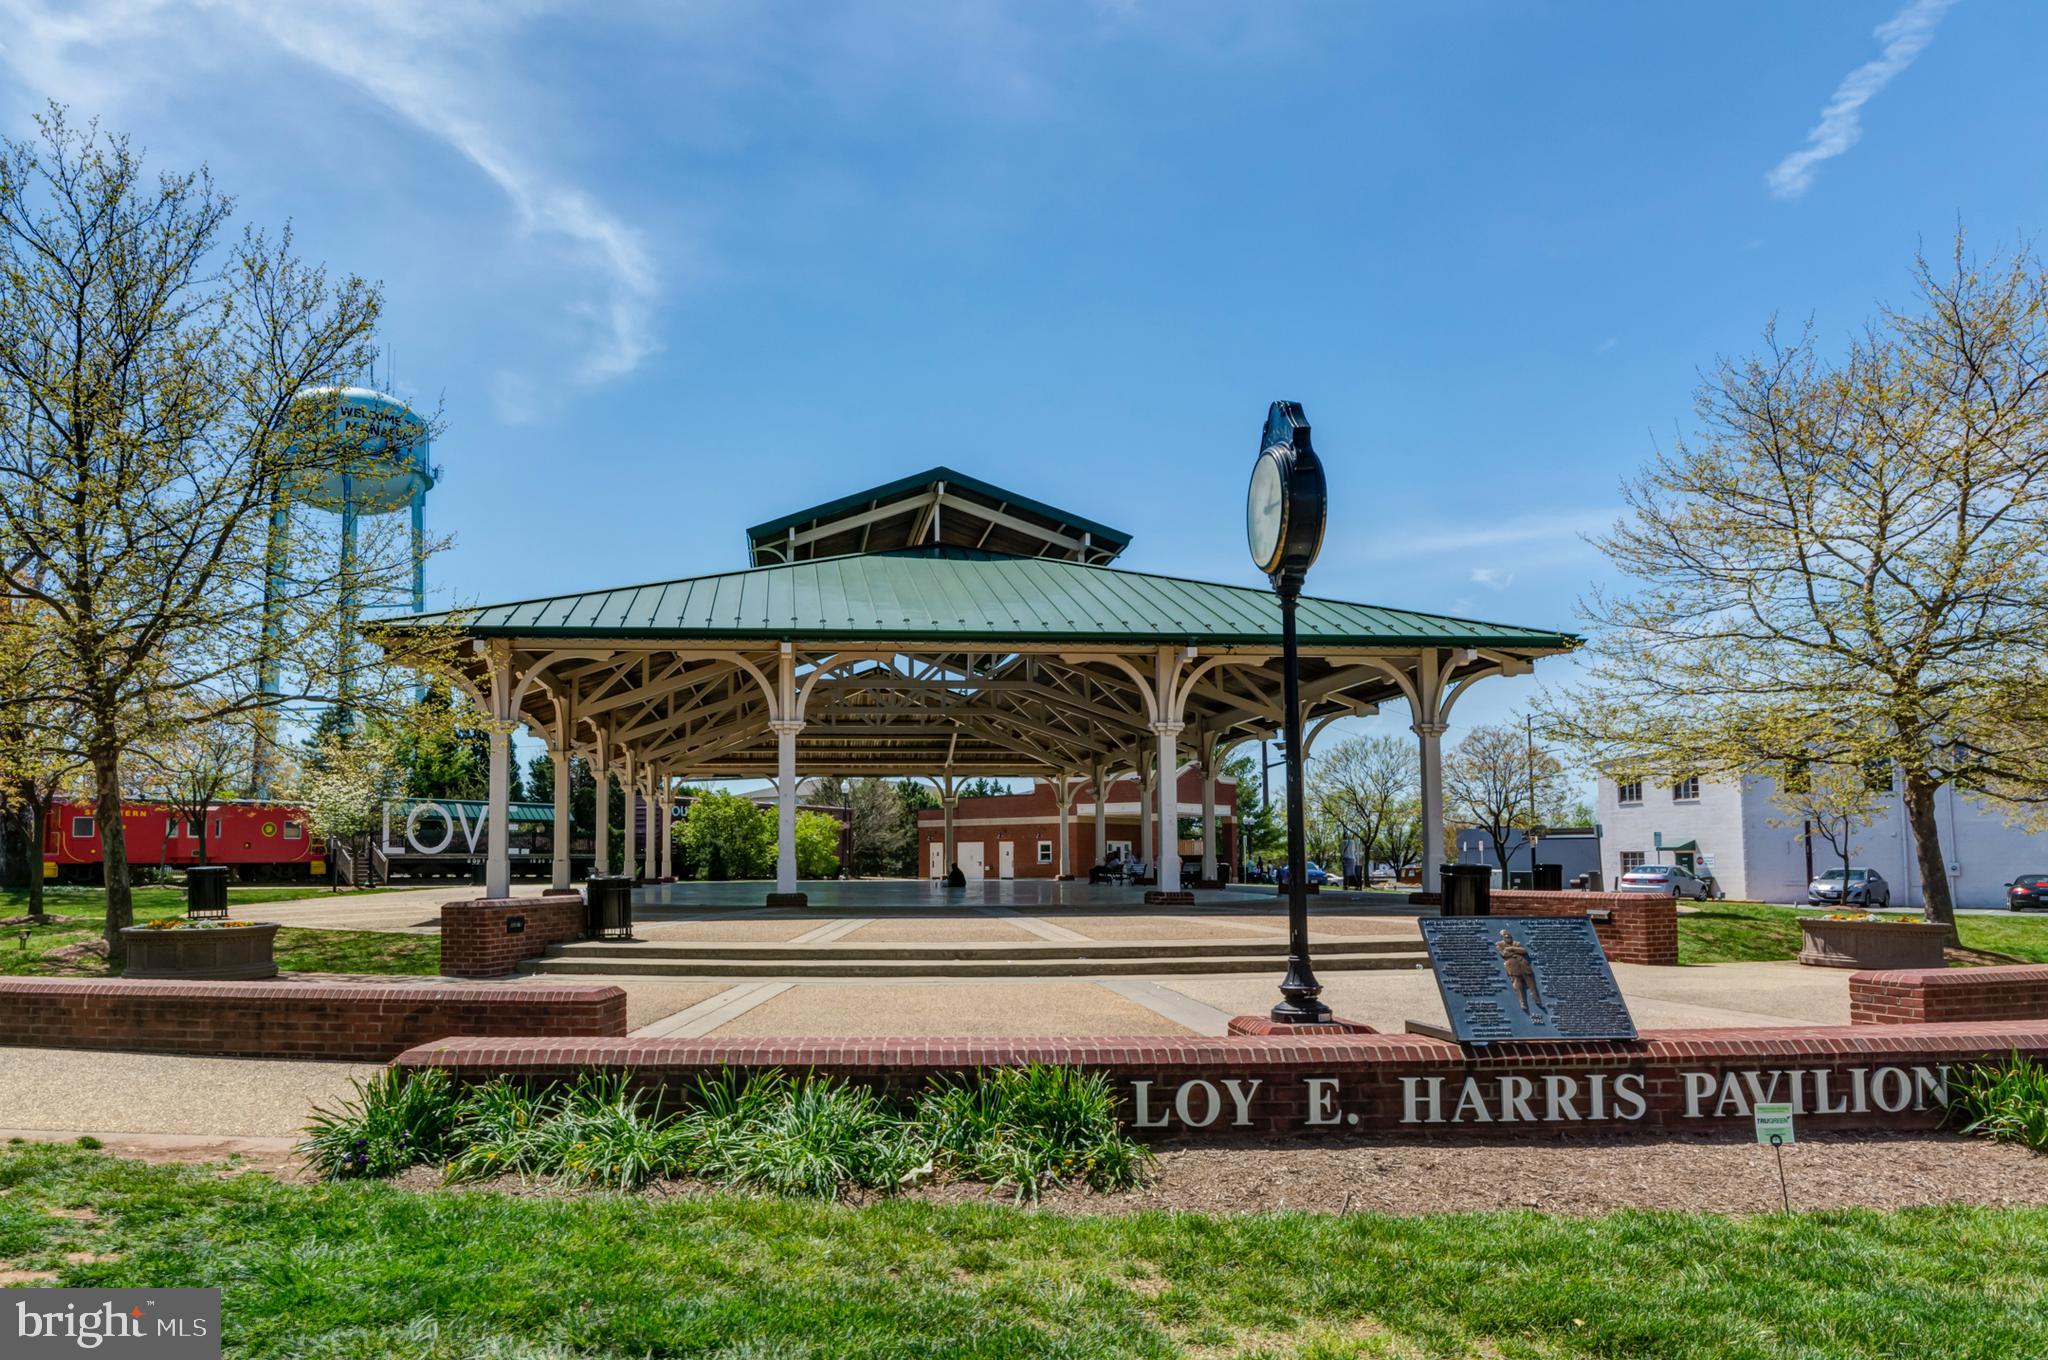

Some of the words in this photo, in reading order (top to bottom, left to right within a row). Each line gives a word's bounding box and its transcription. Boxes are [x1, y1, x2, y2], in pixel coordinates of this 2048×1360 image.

[345, 420, 414, 441] MNASA
[83, 808, 148, 817] SERN
[1130, 1079, 1263, 1127] LOY
[1303, 1078, 1360, 1126] E.
[1398, 1073, 1647, 1123] HARRIS
[1680, 1066, 1951, 1118] PAVILION
